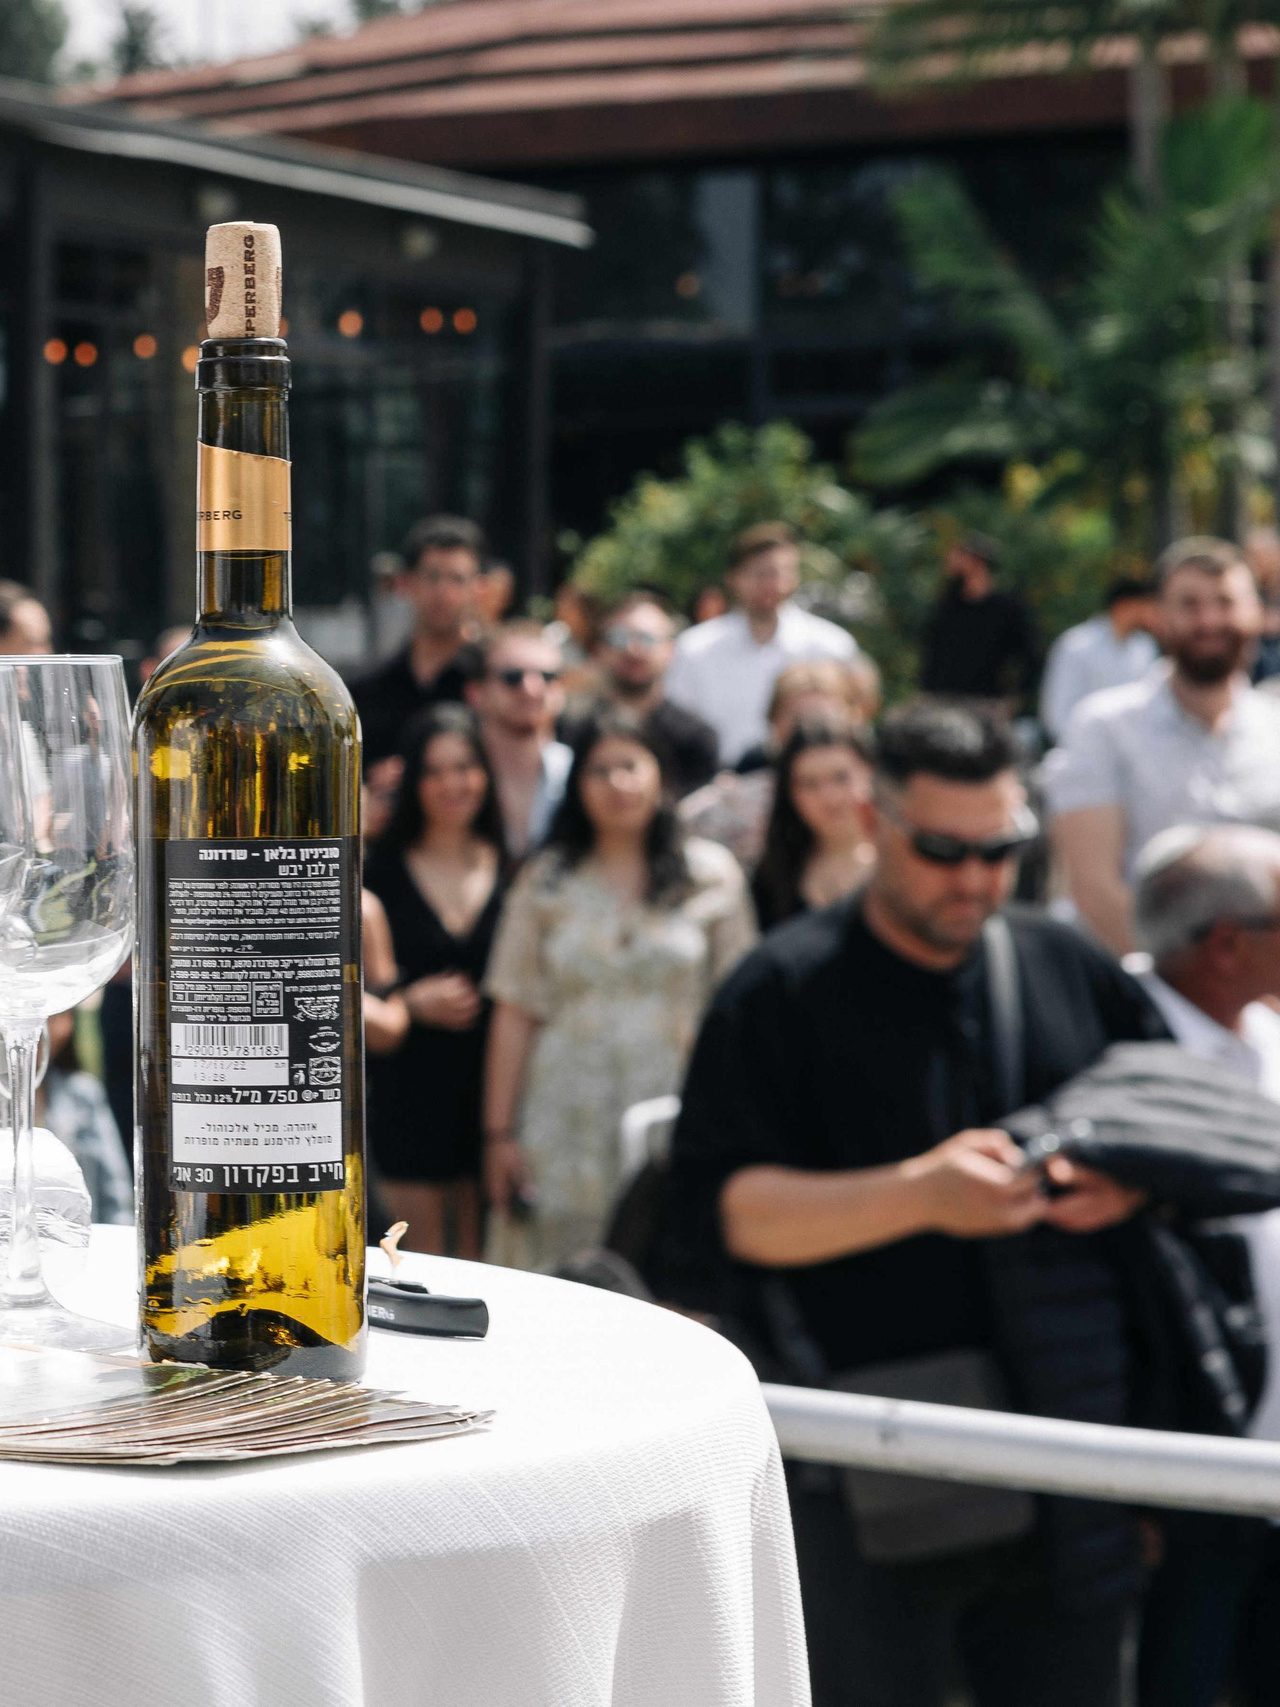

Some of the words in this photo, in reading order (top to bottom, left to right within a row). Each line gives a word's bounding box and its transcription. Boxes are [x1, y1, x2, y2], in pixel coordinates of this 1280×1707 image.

[199, 849, 248, 860] שרדונה
[263, 846, 297, 862] בלאן
[278, 864, 303, 876] יבש
[306, 862, 326, 877] לבן
[328, 863, 340, 876] יין
[174, 1044, 181, 1055] 7
[187, 1045, 229, 1056] 290015
[235, 1045, 280, 1056] 781183
[232, 1087, 262, 1103] מ"ל
[267, 1090, 298, 1103] 750
[319, 1088, 341, 1100] כשר
[254, 1123, 279, 1133] מכיל
[283, 1122, 317, 1132] אזהרה:
[223, 1137, 259, 1147] משתיה
[264, 1135, 300, 1146] להימנע
[306, 1135, 332, 1147] מומלץ
[195, 1168, 214, 1183] 30
[223, 1165, 299, 1188] בפקדון
[308, 1162, 343, 1182] חייב
